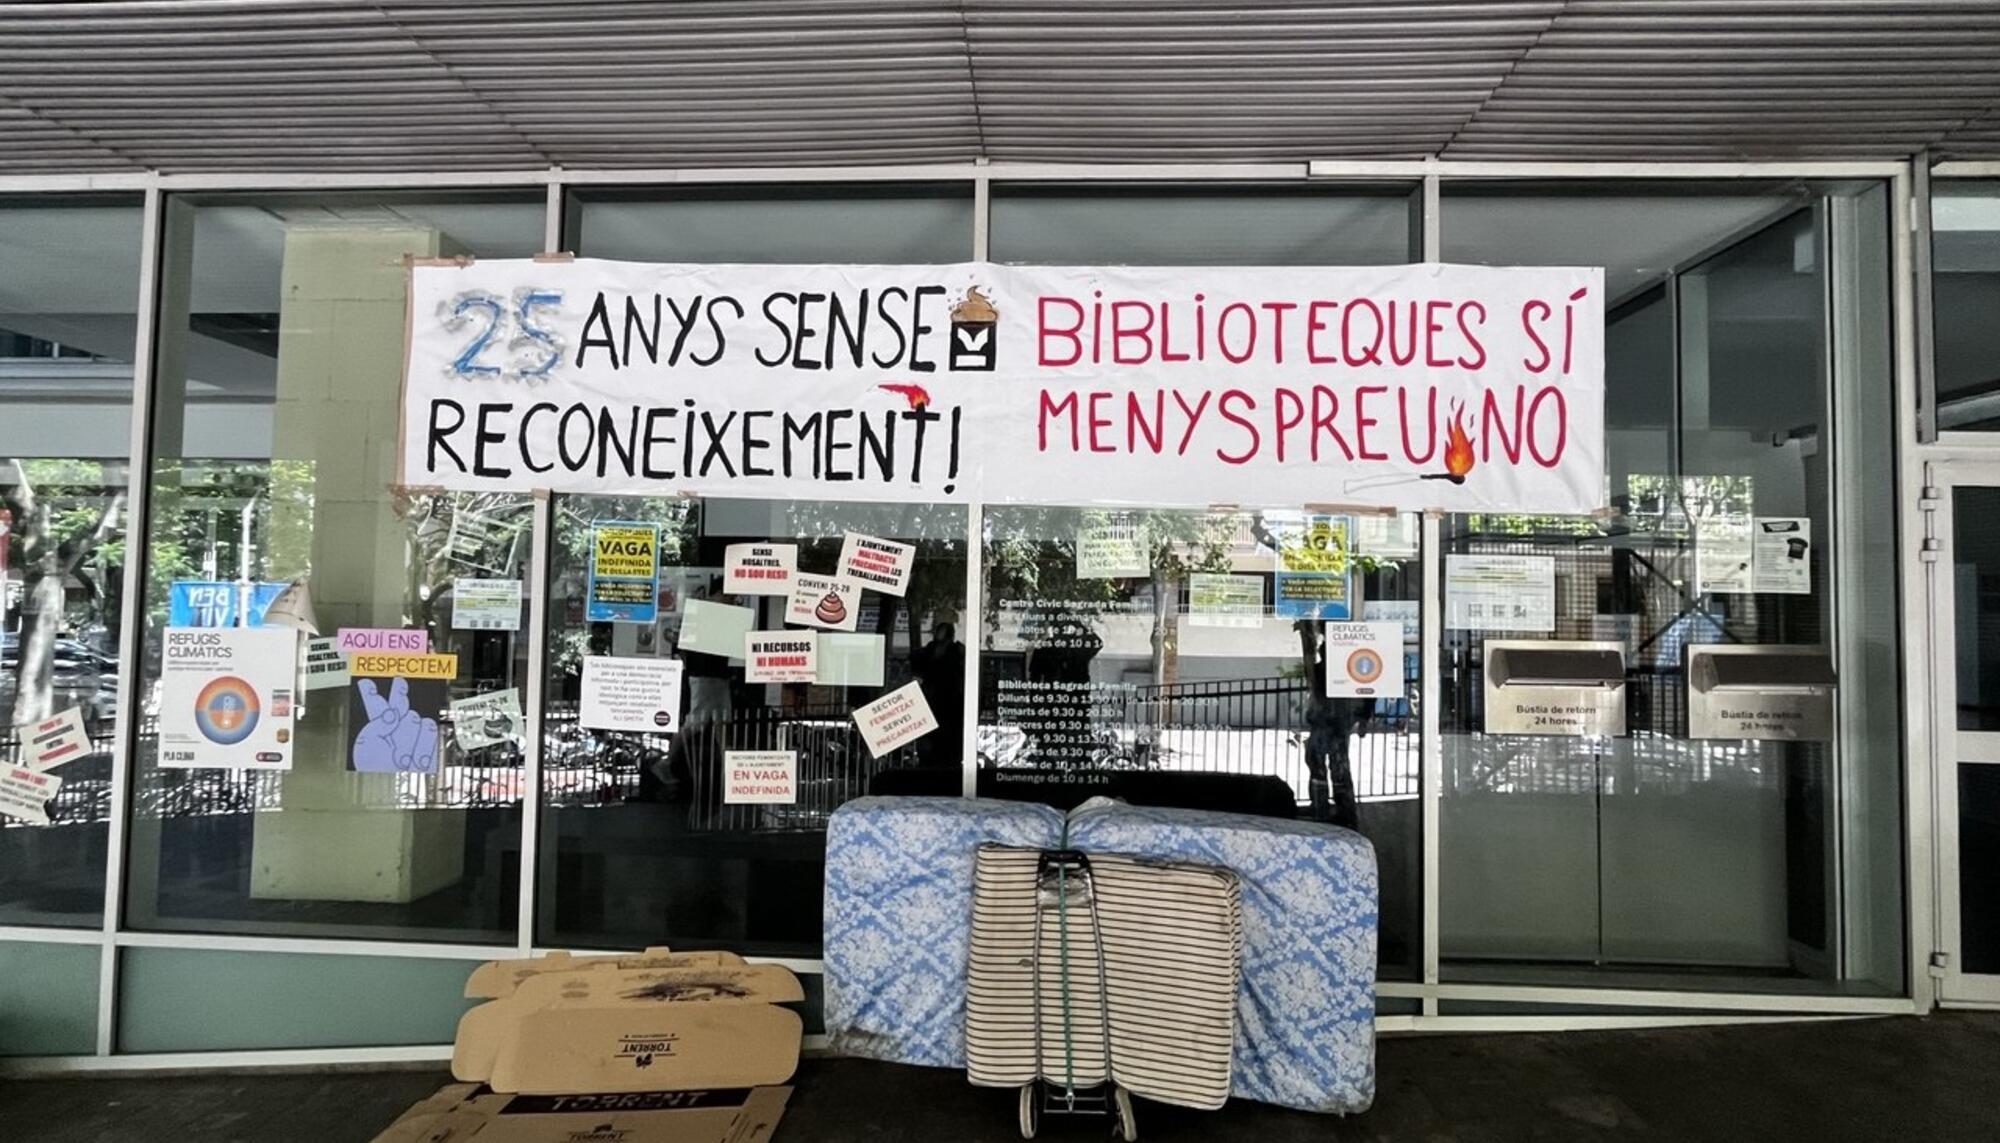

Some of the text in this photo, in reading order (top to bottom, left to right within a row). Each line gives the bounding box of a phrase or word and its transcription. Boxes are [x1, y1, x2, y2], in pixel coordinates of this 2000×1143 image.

[446, 286, 946, 379] 25 ANYS SENSE
[1522, 287, 1588, 374] SÍ
[1038, 385, 1568, 468] MENYSPREU NO
[599, 541, 652, 556] VAGA
[598, 558, 652, 568] INDEFINIDA
[999, 599, 1034, 608] Centre
[1063, 599, 1107, 609] Sagrada
[168, 633, 221, 645] REFUGIS
[343, 631, 420, 650] AQUÍ ENS
[1070, 639, 1082, 648] 10
[752, 642, 812, 653] NI RECURSOS
[356, 656, 451, 674] RESPECTEM
[768, 656, 808, 667] HUMANS
[998, 681, 1051, 690] Biblioteca
[1053, 681, 1096, 691] Sagrada
[998, 693, 1030, 703] Dilluns
[1032, 694, 1045, 703] de
[1046, 694, 1070, 703] 9.30
[871, 694, 904, 714] SECTOR
[1516, 704, 1596, 714] Bústia de retorn
[869, 700, 915, 727] FEMINITZAT
[997, 706, 1036, 716] Dimarts
[1037, 707, 1050, 716] de
[1052, 707, 1075, 717] 9.30
[1077, 709, 1084, 717] a
[882, 714, 912, 733] SERVEI
[1044, 721, 1057, 730] de
[1059, 721, 1082, 730] 9.30
[1534, 717, 1577, 725] 24 hores
[1043, 733, 1066, 743] 9.30
[1068, 735, 1075, 743] a
[1046, 747, 1058, 756] de
[1060, 747, 1083, 757] 9.30
[1040, 761, 1052, 770] de
[734, 770, 789, 780] EN VAGA
[996, 773, 1109, 784] Diumenge de 10 a 14 h
[731, 786, 790, 795] INDEFINIDA
[622, 1042, 671, 1053] TORRENT
[552, 1092, 708, 1110] TORRENT
